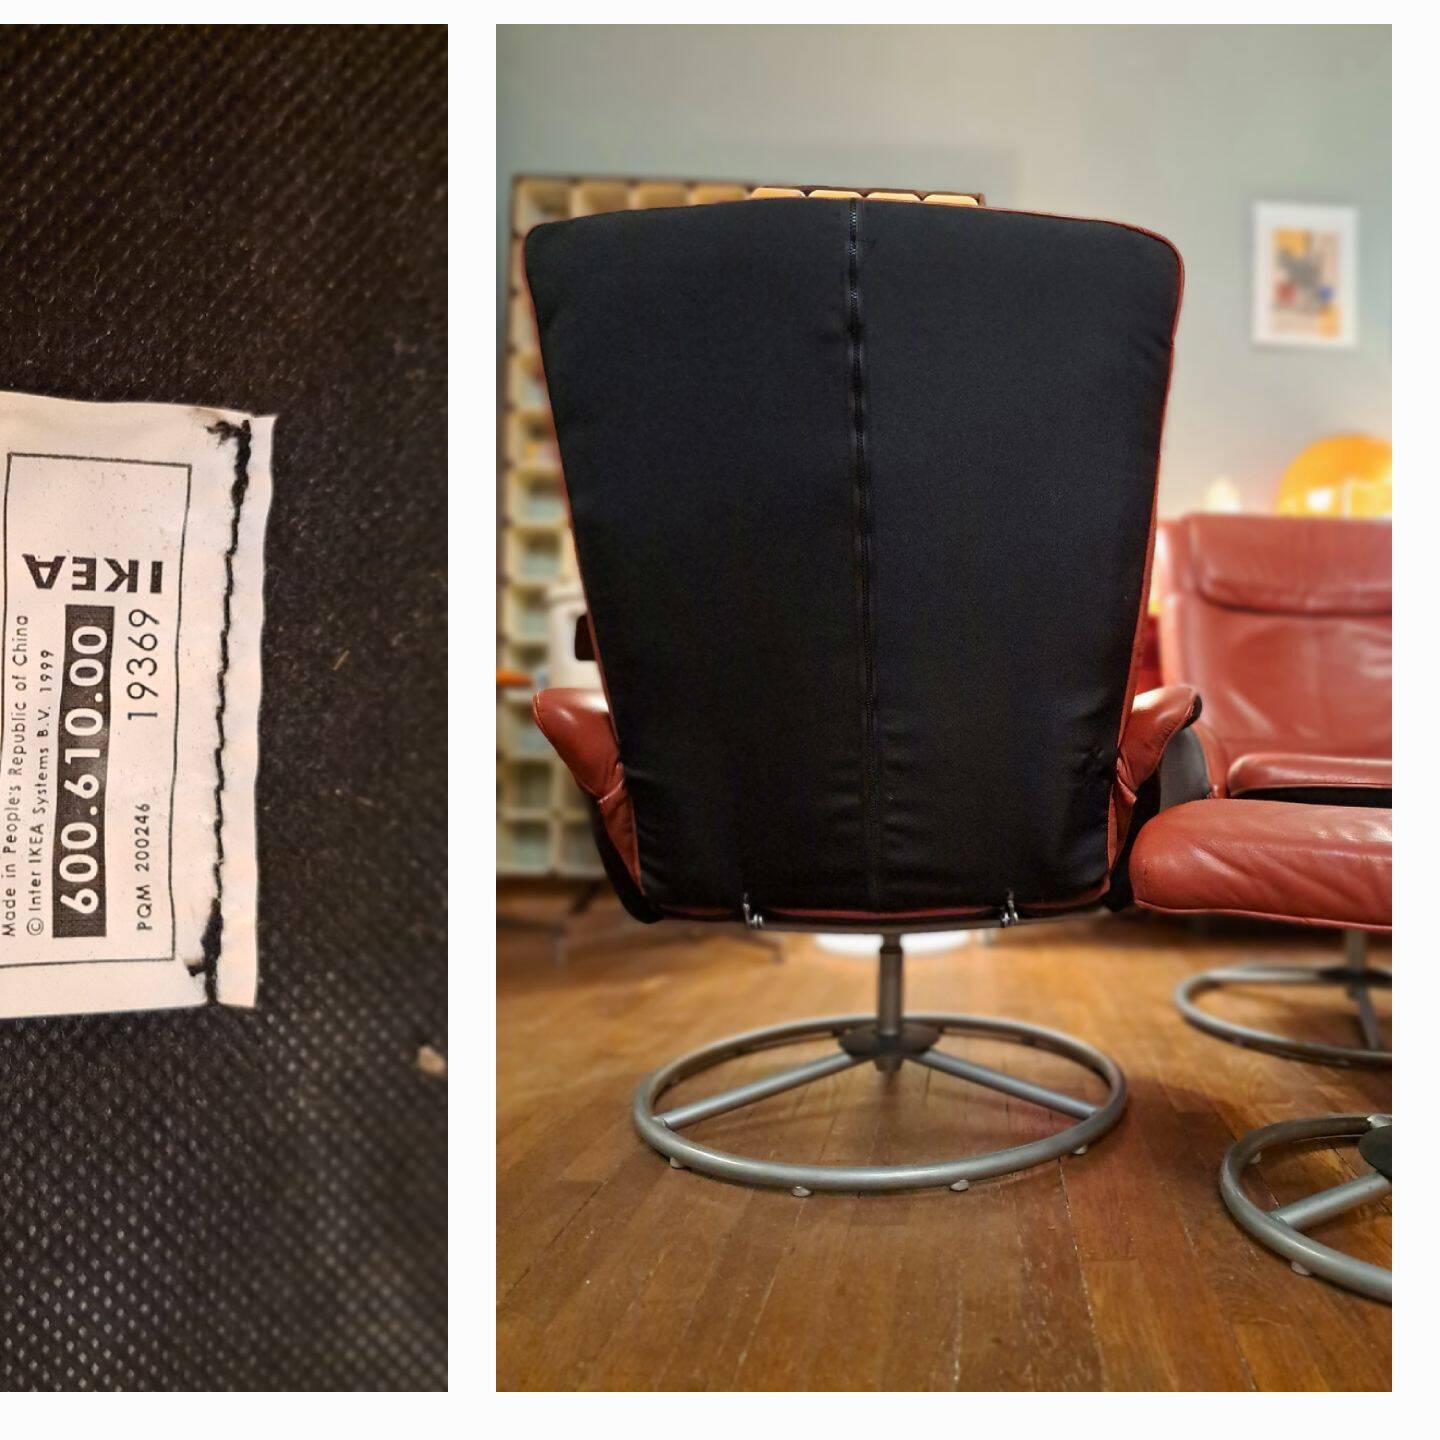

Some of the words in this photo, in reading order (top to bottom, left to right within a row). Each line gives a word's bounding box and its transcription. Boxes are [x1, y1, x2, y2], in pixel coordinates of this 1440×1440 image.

[22, 553, 164, 594] IKEA
[12, 615, 28, 666] China
[11, 675, 27, 691] of
[40, 649, 54, 692] 1999
[127, 608, 159, 721] 19369
[9, 702, 27, 775] Republic
[37, 705, 51, 738] B.V.
[33, 747, 49, 814] Systems
[59, 625, 108, 915] 600.610.00
[3, 784, 22, 853] People's
[135, 802, 150, 872] 200246
[29, 823, 44, 863] IKEA
[3, 863, 15, 878] in
[28, 871, 42, 911] Inter
[3, 888, 16, 936] Made
[136, 884, 152, 931] PQM
